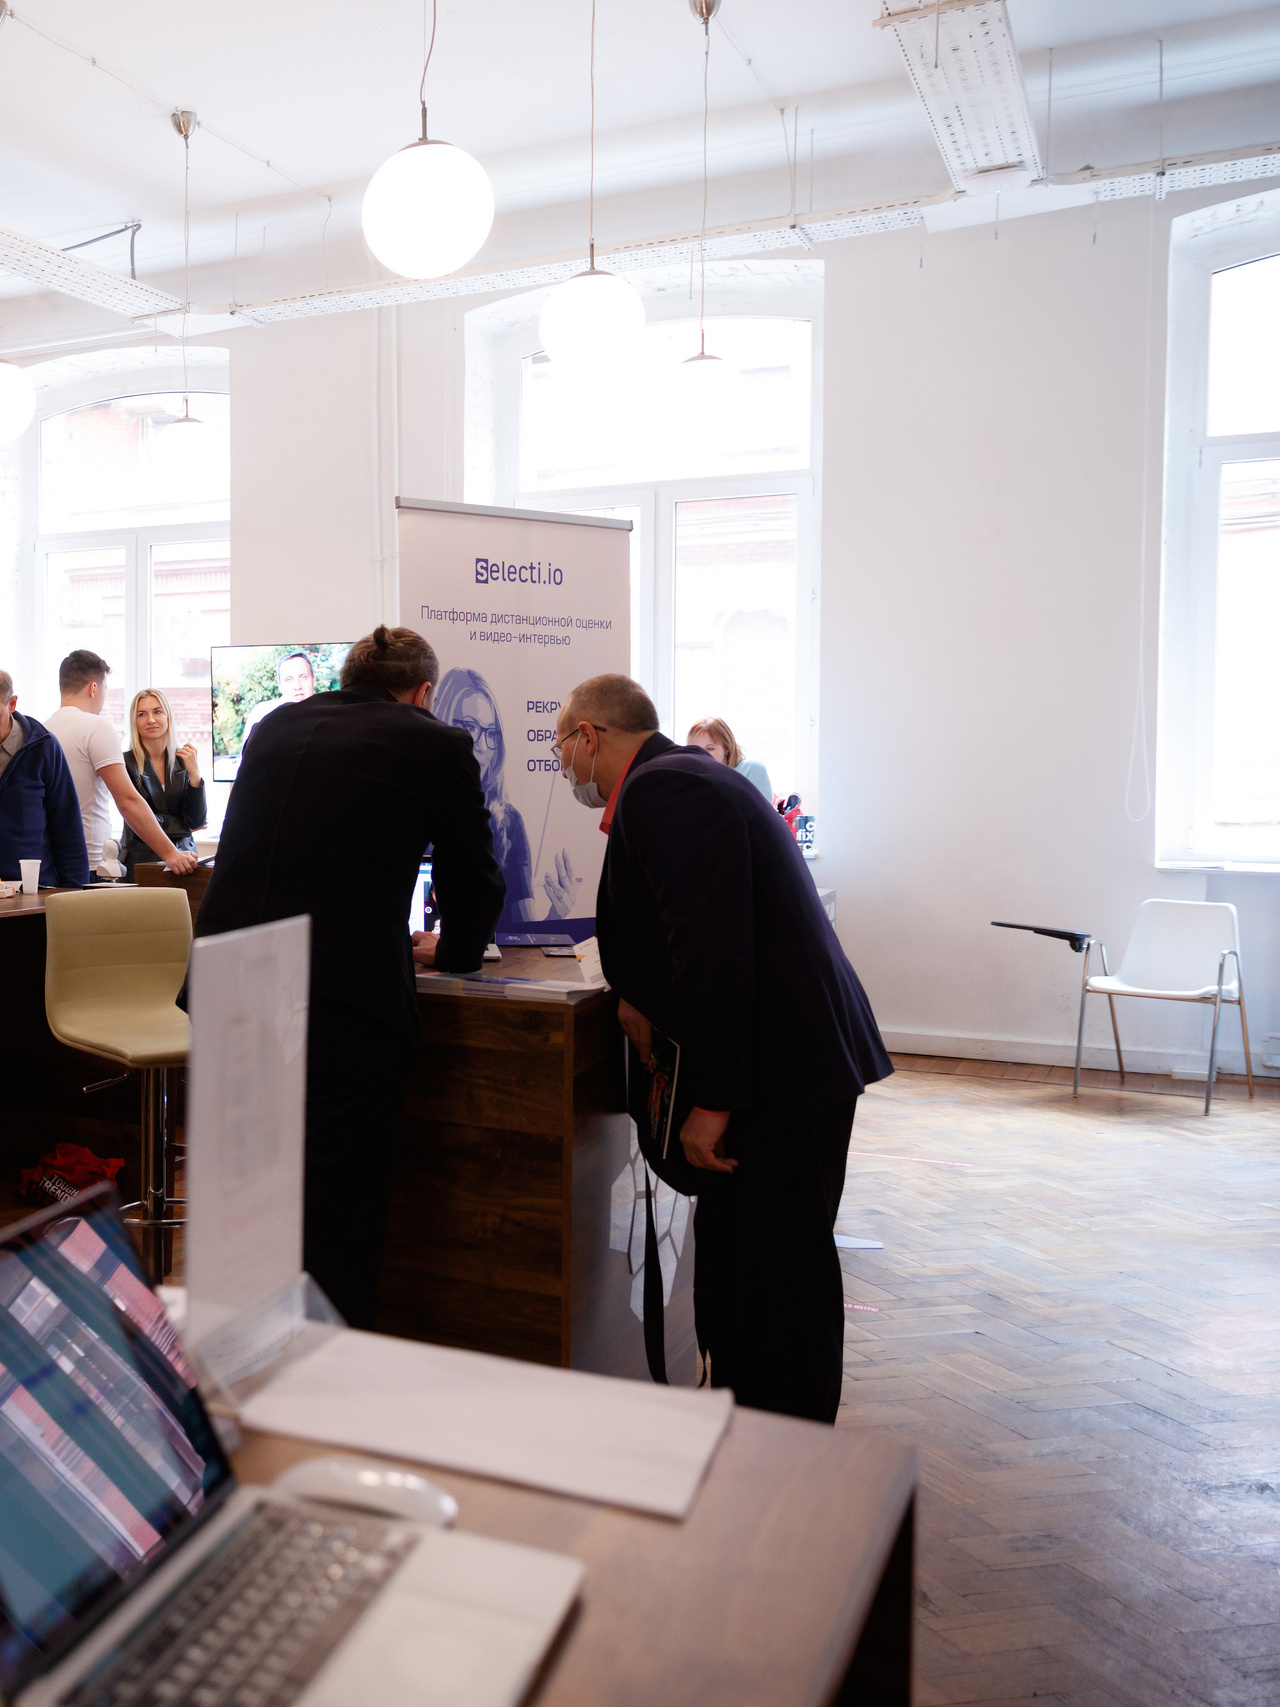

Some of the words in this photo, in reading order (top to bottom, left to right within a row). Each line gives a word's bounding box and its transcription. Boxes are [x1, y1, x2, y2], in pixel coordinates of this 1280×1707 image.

[475, 557, 563, 586] Selecti.io
[420, 605, 488, 626] Платформа
[490, 613, 574, 628] дистанционной
[575, 617, 612, 630] оценки
[469, 630, 477, 641] и
[479, 630, 571, 648] видео-интервью
